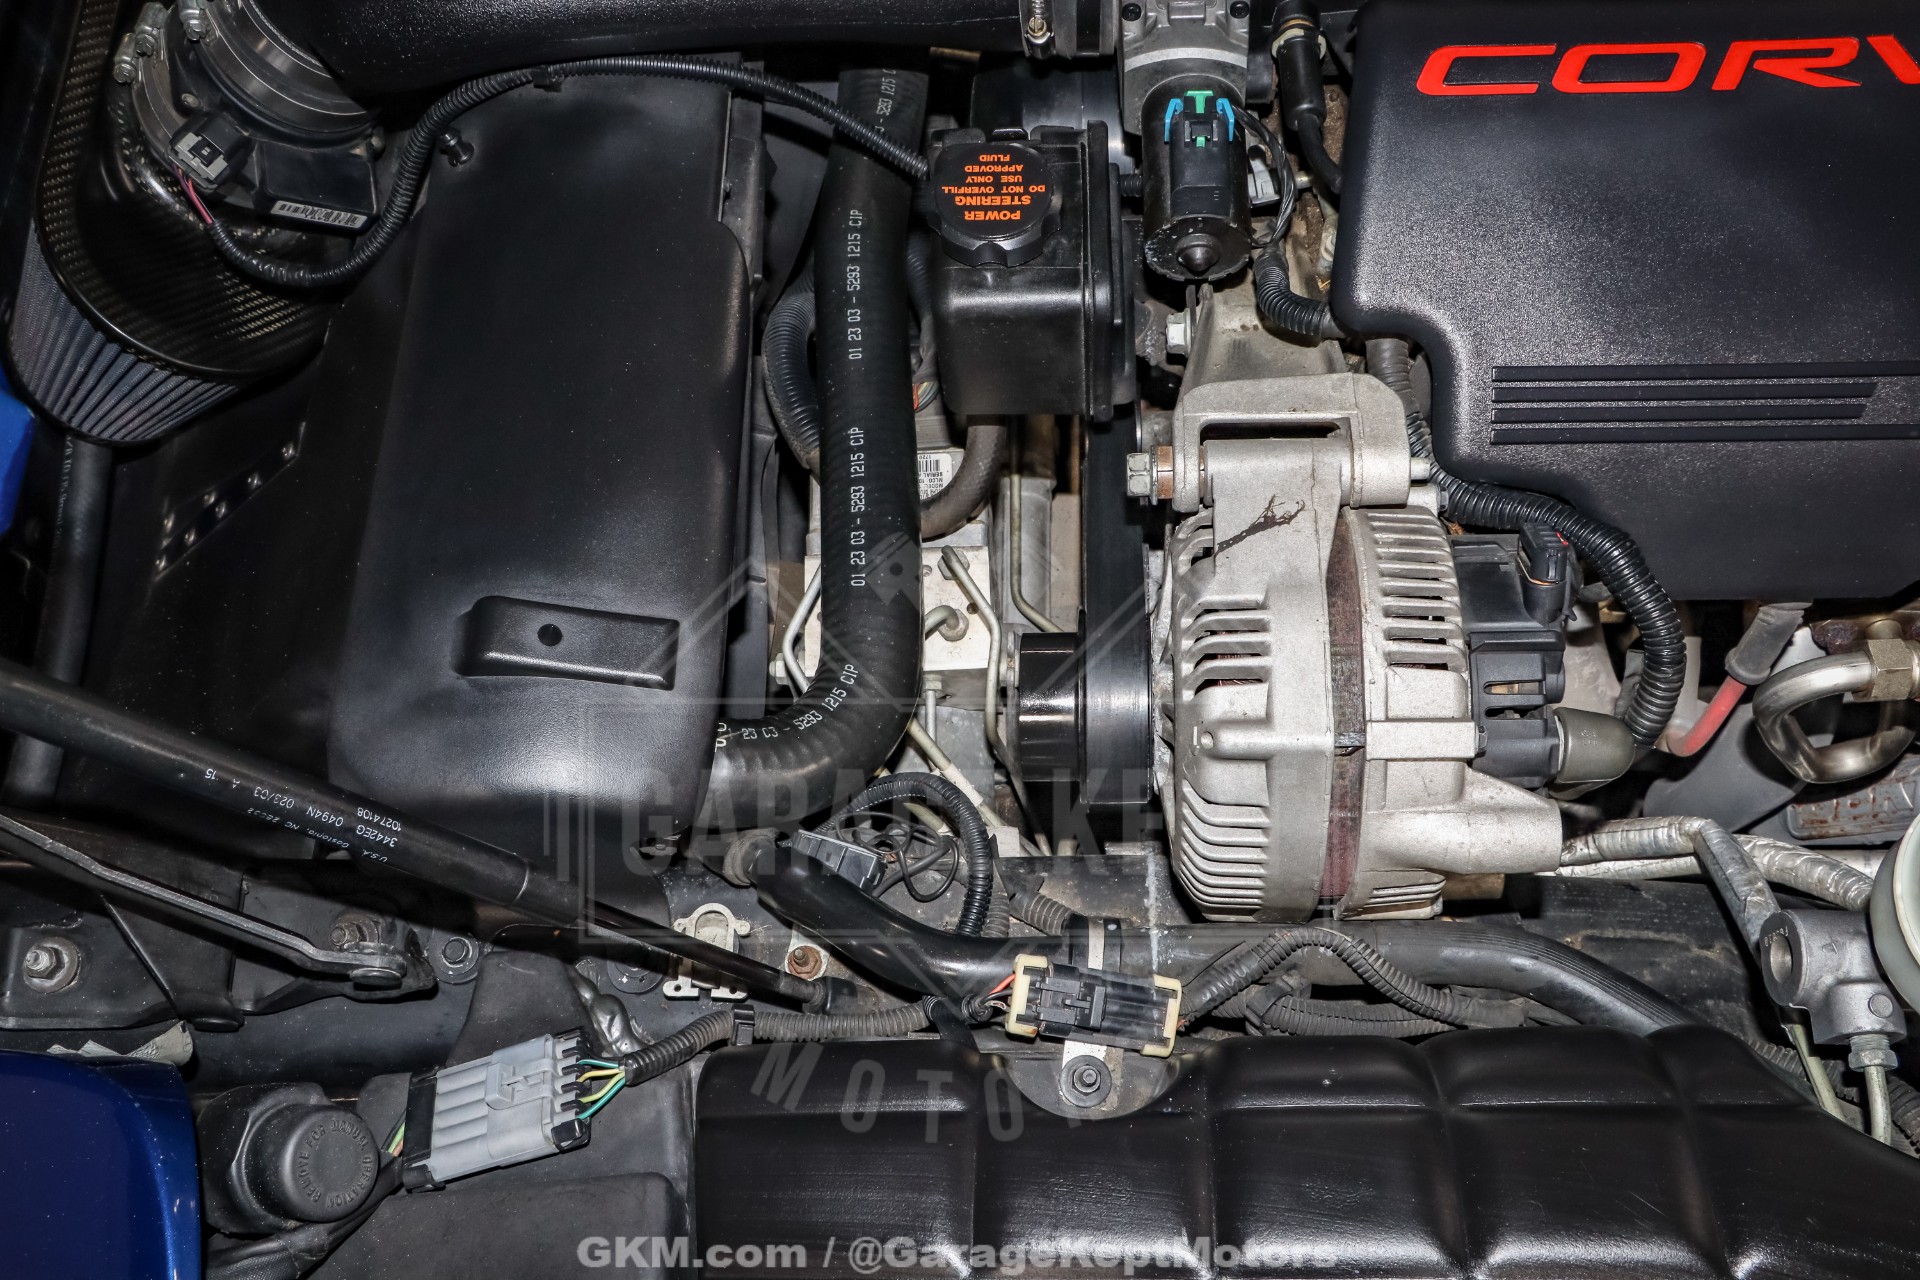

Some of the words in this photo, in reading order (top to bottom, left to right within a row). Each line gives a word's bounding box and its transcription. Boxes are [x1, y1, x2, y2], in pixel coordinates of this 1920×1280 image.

[881, 77, 896, 95] 1215
[979, 154, 1011, 162] FLUID
[964, 164, 1024, 173] APPROVED
[965, 175, 993, 184] ONLY
[1001, 175, 1022, 183] USE
[942, 186, 994, 194] OVERFILL
[1001, 185, 1024, 194] NOT
[1029, 185, 1046, 193] DO
[954, 195, 1031, 206] STEERING
[849, 209, 863, 227] CIP
[964, 210, 1021, 221] POWER
[847, 233, 861, 257] 1215
[847, 265, 861, 292] 5293
[847, 308, 861, 323] 03
[847, 327, 862, 341] 23
[849, 347, 863, 360] 01
[850, 427, 864, 446] CIP
[850, 452, 865, 478] 1215
[850, 485, 865, 513] 5293
[850, 530, 865, 545] 03
[850, 550, 866, 565] 23
[850, 573, 866, 587] 01
[742, 727, 758, 740] 23
[793, 710, 823, 730] 5293
[822, 687, 848, 711] 1215
[840, 663, 859, 685] CIP
[306, 806, 344, 827] 0494N
[357, 807, 402, 832] 10274108
[284, 822, 300, 831] NC
[355, 824, 398, 848] 3442EG
[304, 1124, 327, 1149] FOR
[331, 1120, 369, 1151] MANUAL
[298, 1152, 321, 1202] REMOVE
[325, 1154, 373, 1209] OPERATION
